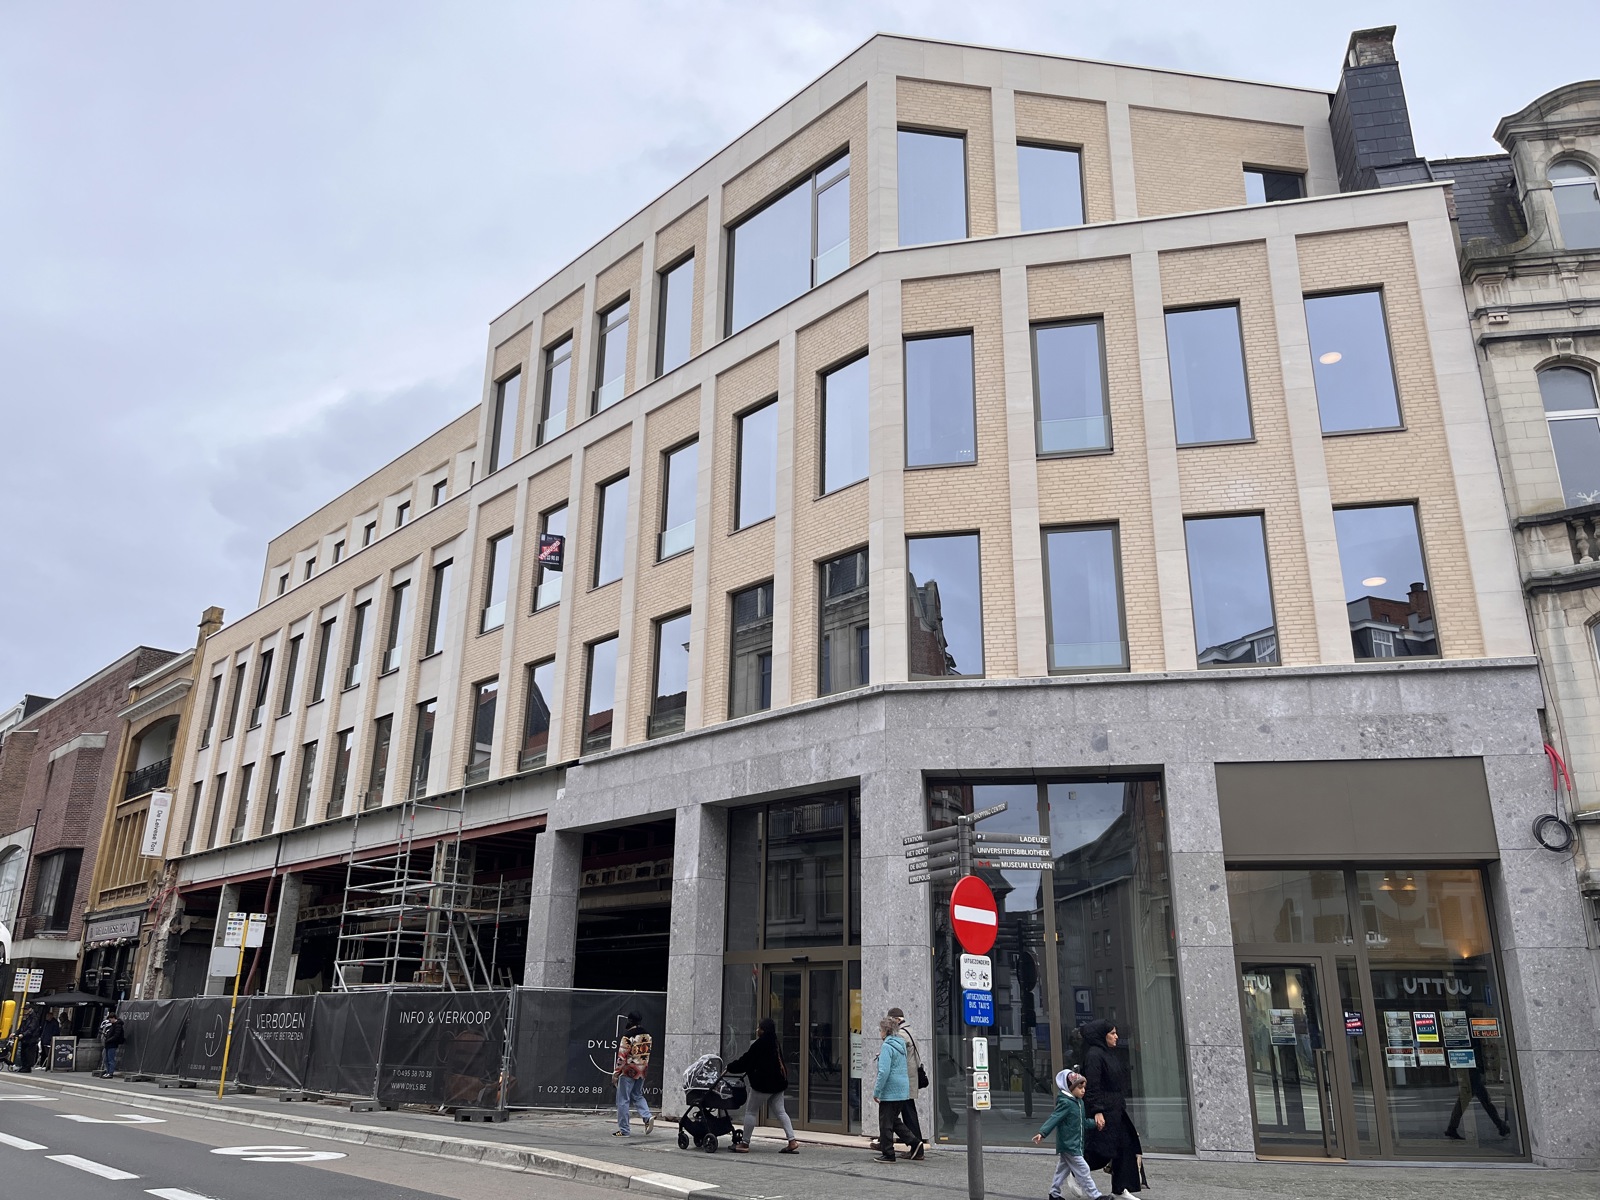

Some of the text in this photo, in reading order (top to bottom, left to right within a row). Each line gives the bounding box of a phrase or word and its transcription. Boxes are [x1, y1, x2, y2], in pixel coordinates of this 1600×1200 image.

[157, 810, 163, 818] De
[904, 835, 923, 844] STATION
[1019, 836, 1048, 844] LADEUZE
[906, 847, 929, 858] HET DEPOT
[977, 847, 1050, 857] UNIVERSITEITSBIBLIOTHEEK
[910, 861, 928, 871] DE BOND
[1001, 861, 1028, 869] MUSEUM
[1029, 862, 1053, 870] LEUVEN
[909, 873, 931, 883] KINEPOLIS
[964, 958, 990, 966] UITGEZONDERD
[966, 993, 992, 1002] UITGEZONDERD
[256, 1012, 306, 1029] VERBODEN
[399, 1011, 491, 1025] INFO & VERKOOP
[970, 1016, 990, 1024] AUTOCARS
[588, 1040, 618, 1049] DYLS
[547, 1086, 558, 1094] 02
[560, 1086, 576, 1094] 252
[578, 1086, 590, 1094] 08
[592, 1086, 603, 1094] 88
